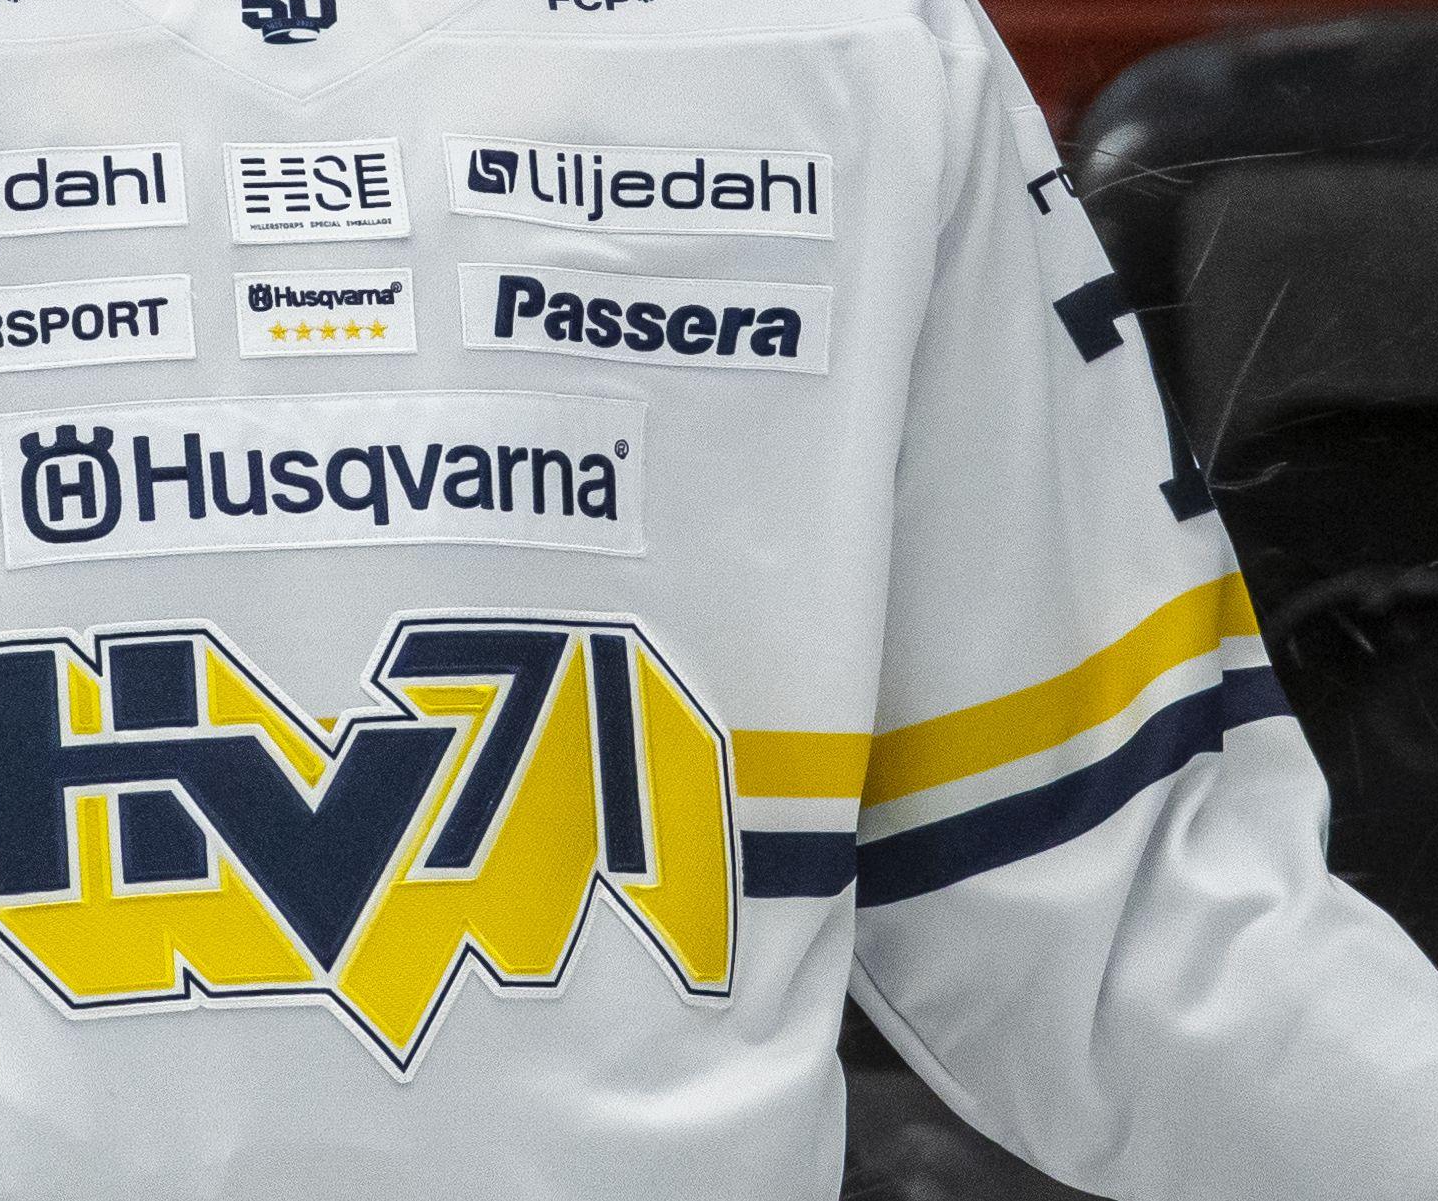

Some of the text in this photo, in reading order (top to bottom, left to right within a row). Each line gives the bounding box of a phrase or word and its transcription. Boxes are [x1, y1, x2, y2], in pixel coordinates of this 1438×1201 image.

[240, 153, 392, 213] HSE
[529, 149, 817, 222] Liljedahl
[494, 275, 802, 358] Passera
